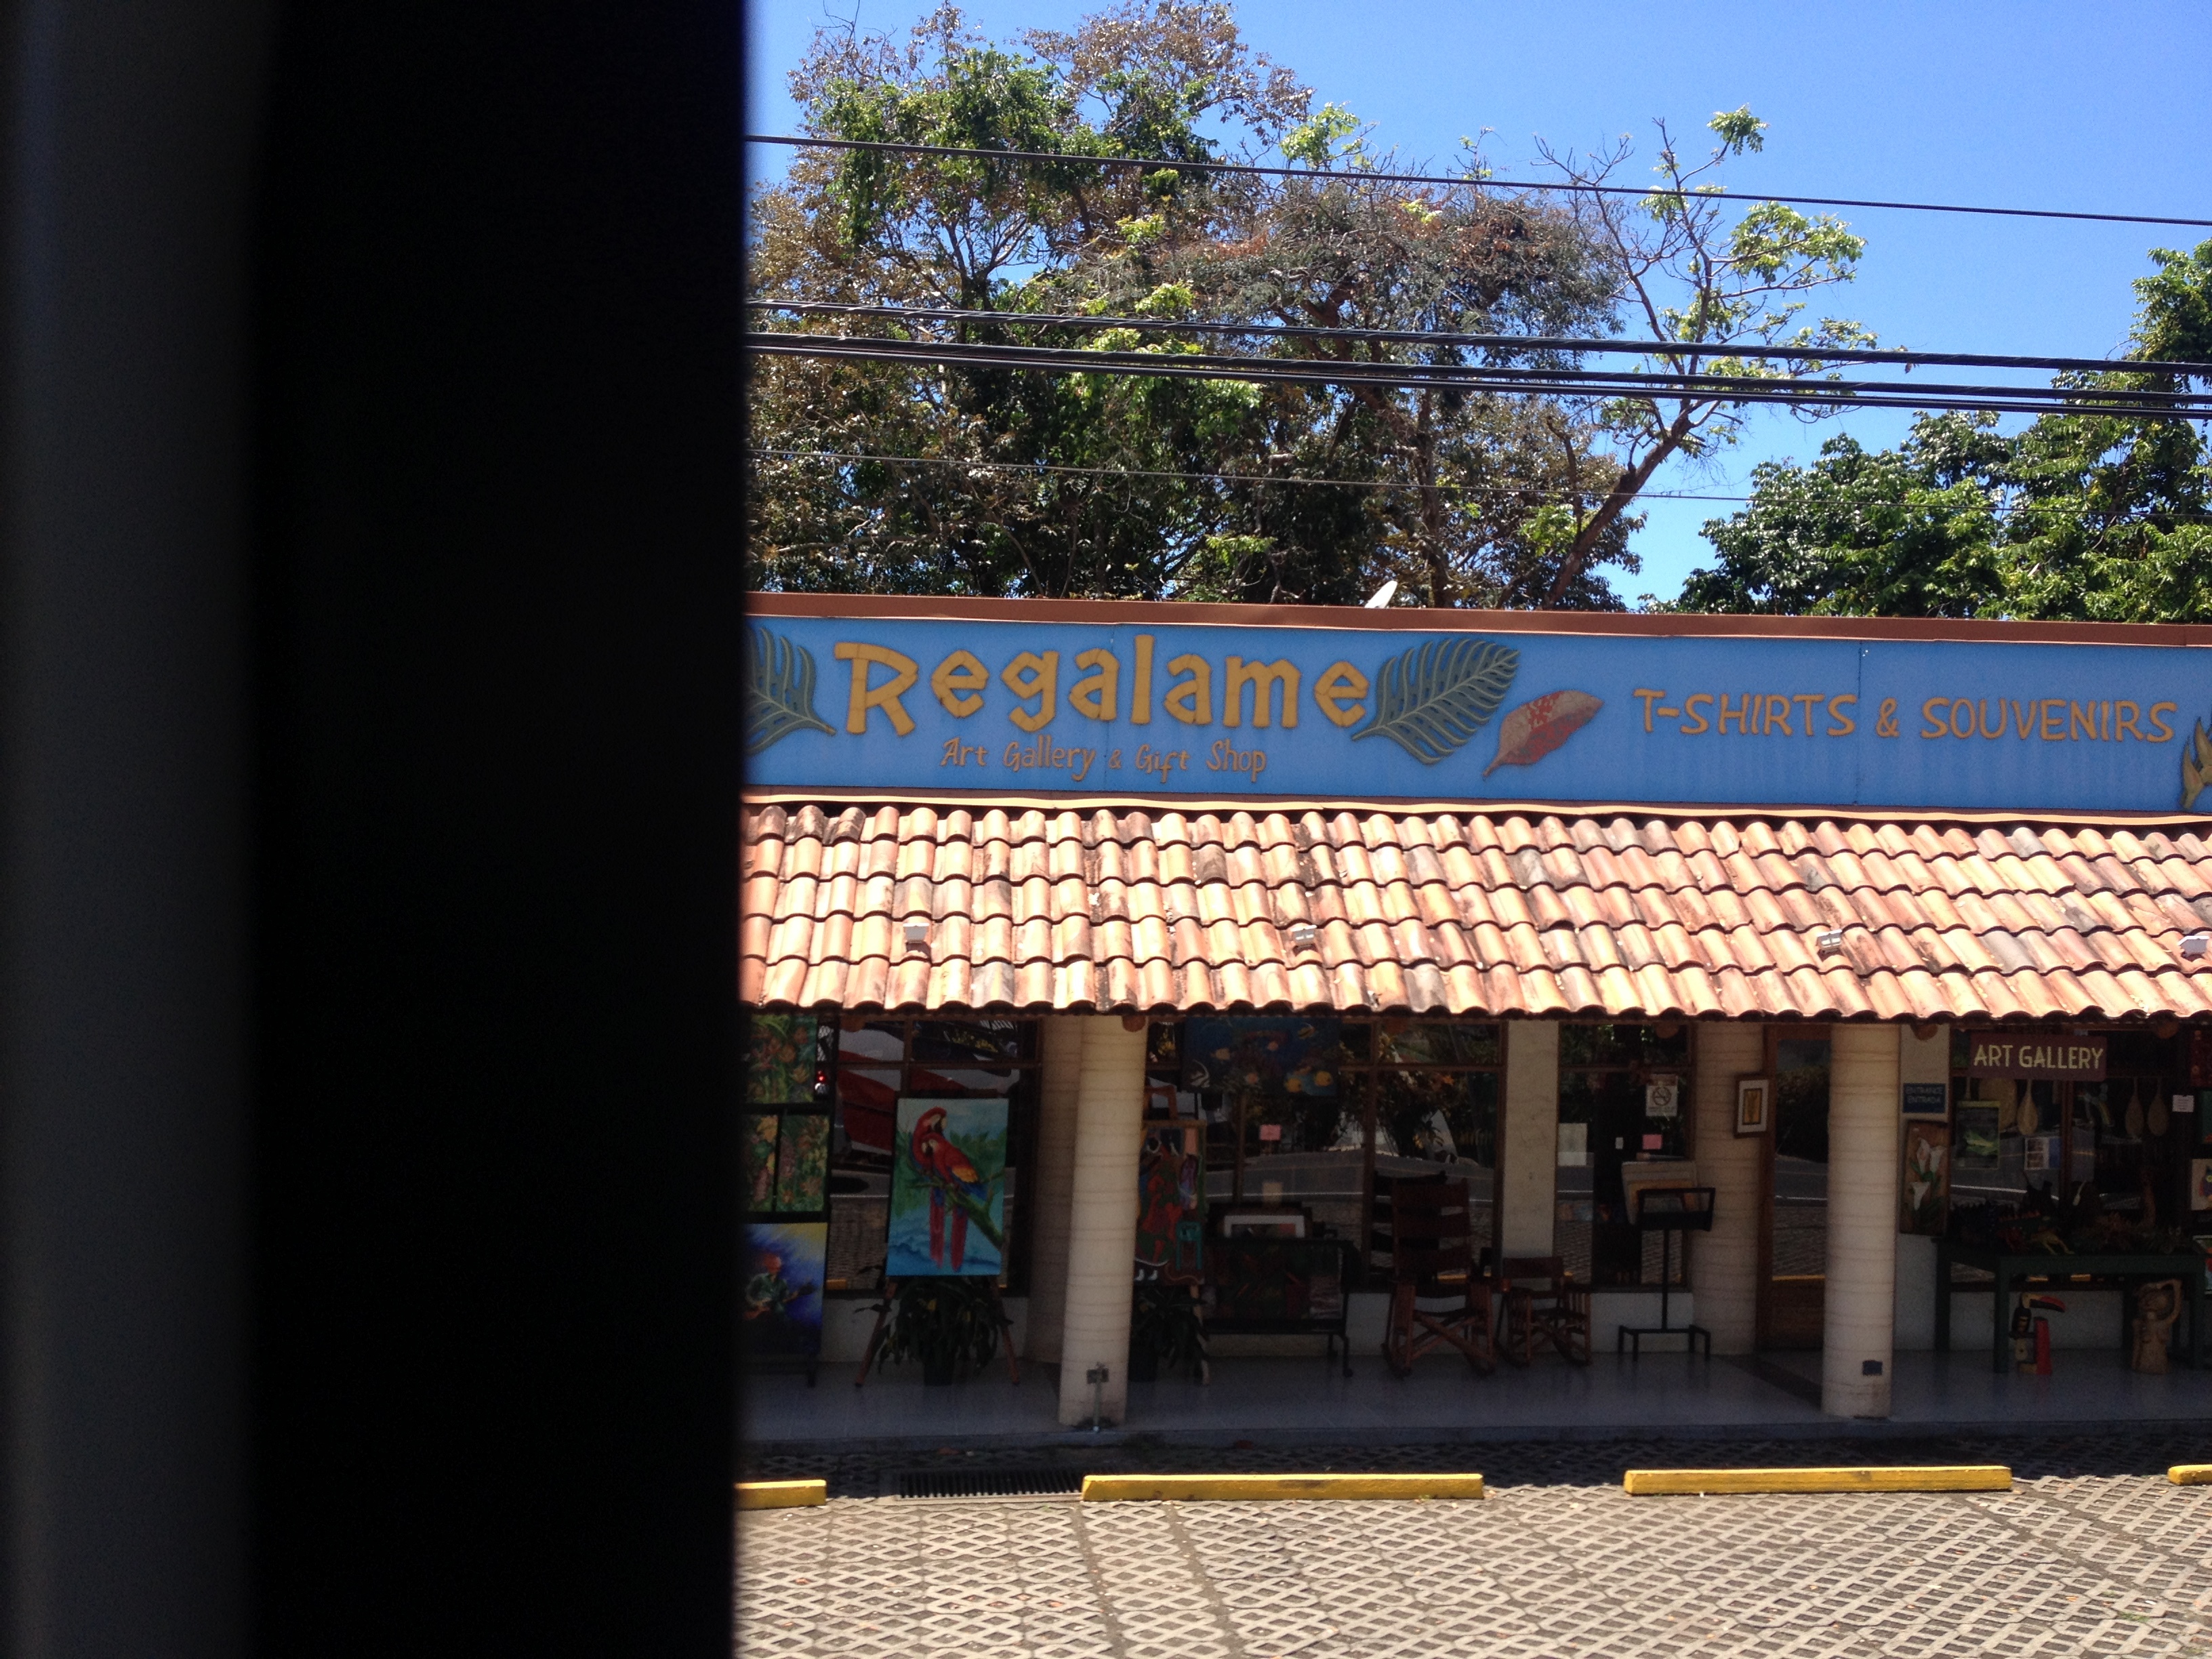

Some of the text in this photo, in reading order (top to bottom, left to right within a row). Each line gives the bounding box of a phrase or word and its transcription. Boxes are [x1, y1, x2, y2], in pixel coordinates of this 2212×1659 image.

[834, 634, 1369, 737] Regalame
[1633, 687, 2177, 743] T-SHIRTS & SOUVENIRS
[940, 734, 1267, 783] Art Gallery & Gift Shop
[1973, 1044, 2104, 1069] ART GALLERY
